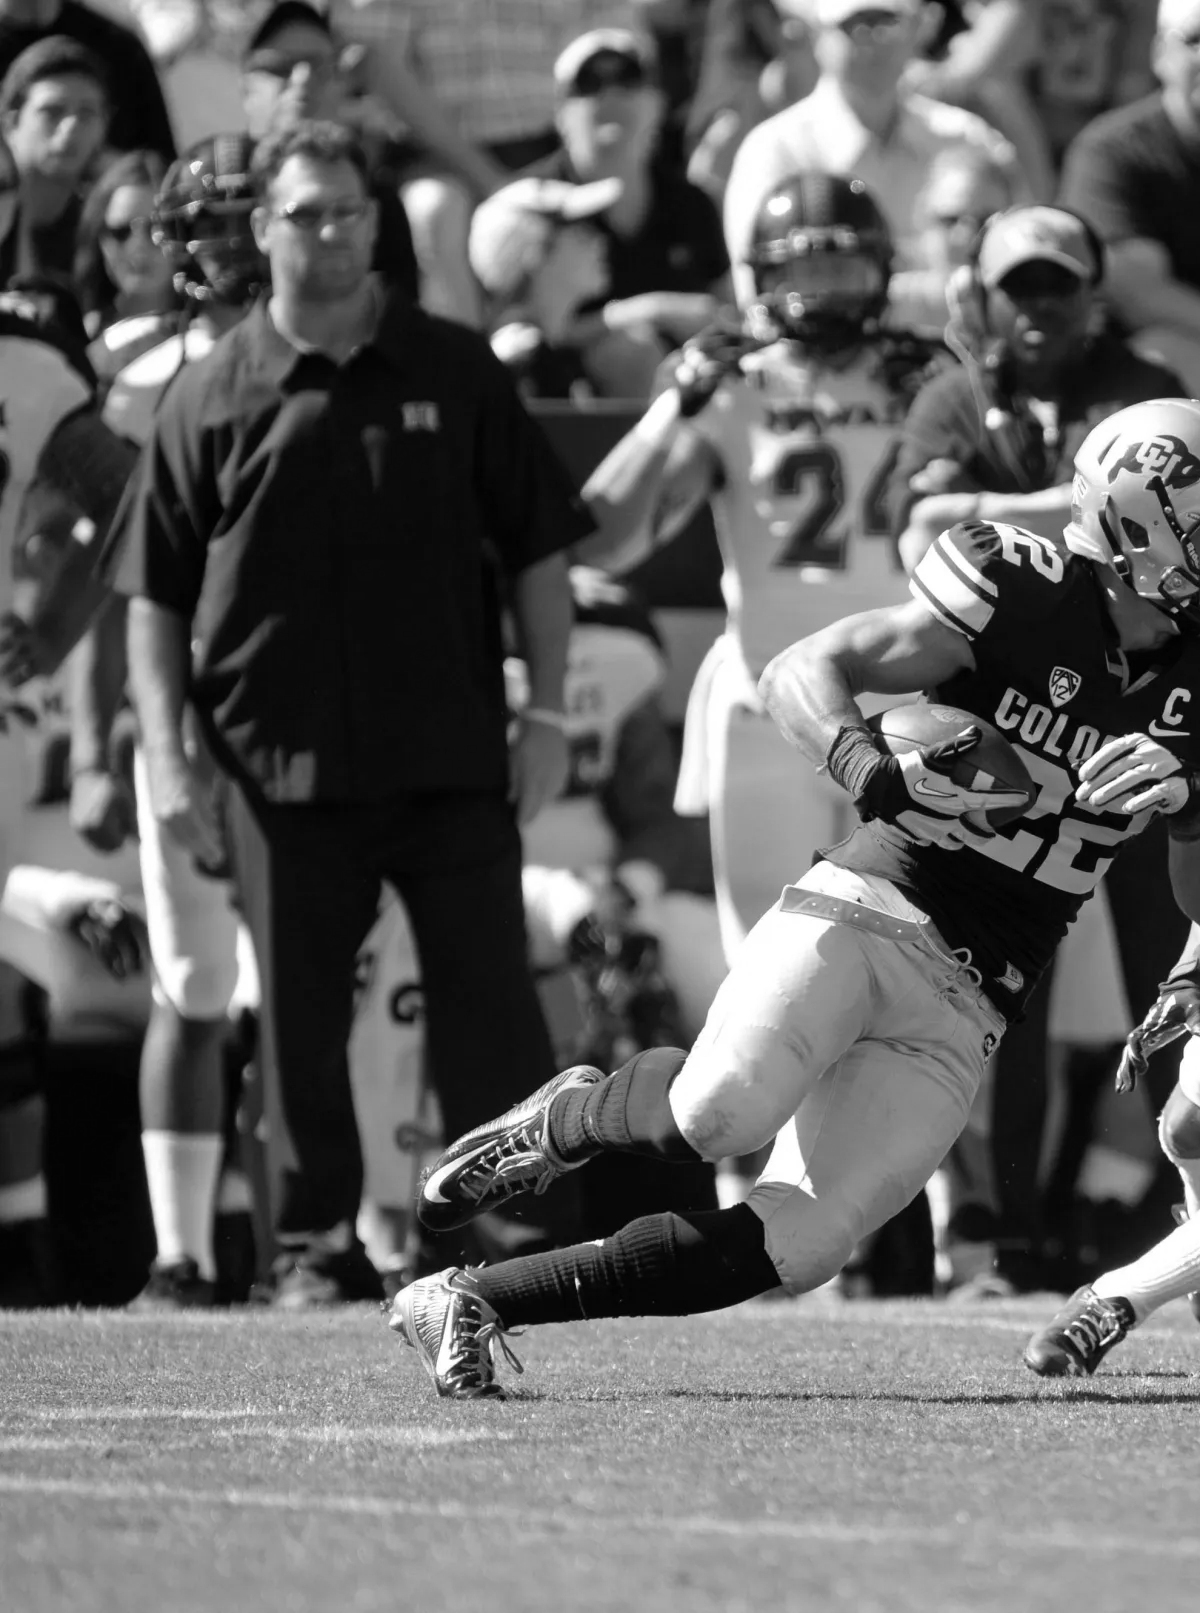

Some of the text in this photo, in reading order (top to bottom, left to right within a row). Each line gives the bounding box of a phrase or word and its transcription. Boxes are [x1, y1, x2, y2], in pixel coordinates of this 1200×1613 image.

[1053, 684, 1070, 701] 12
[1162, 687, 1192, 726] C
[994, 687, 1120, 766] COLO
